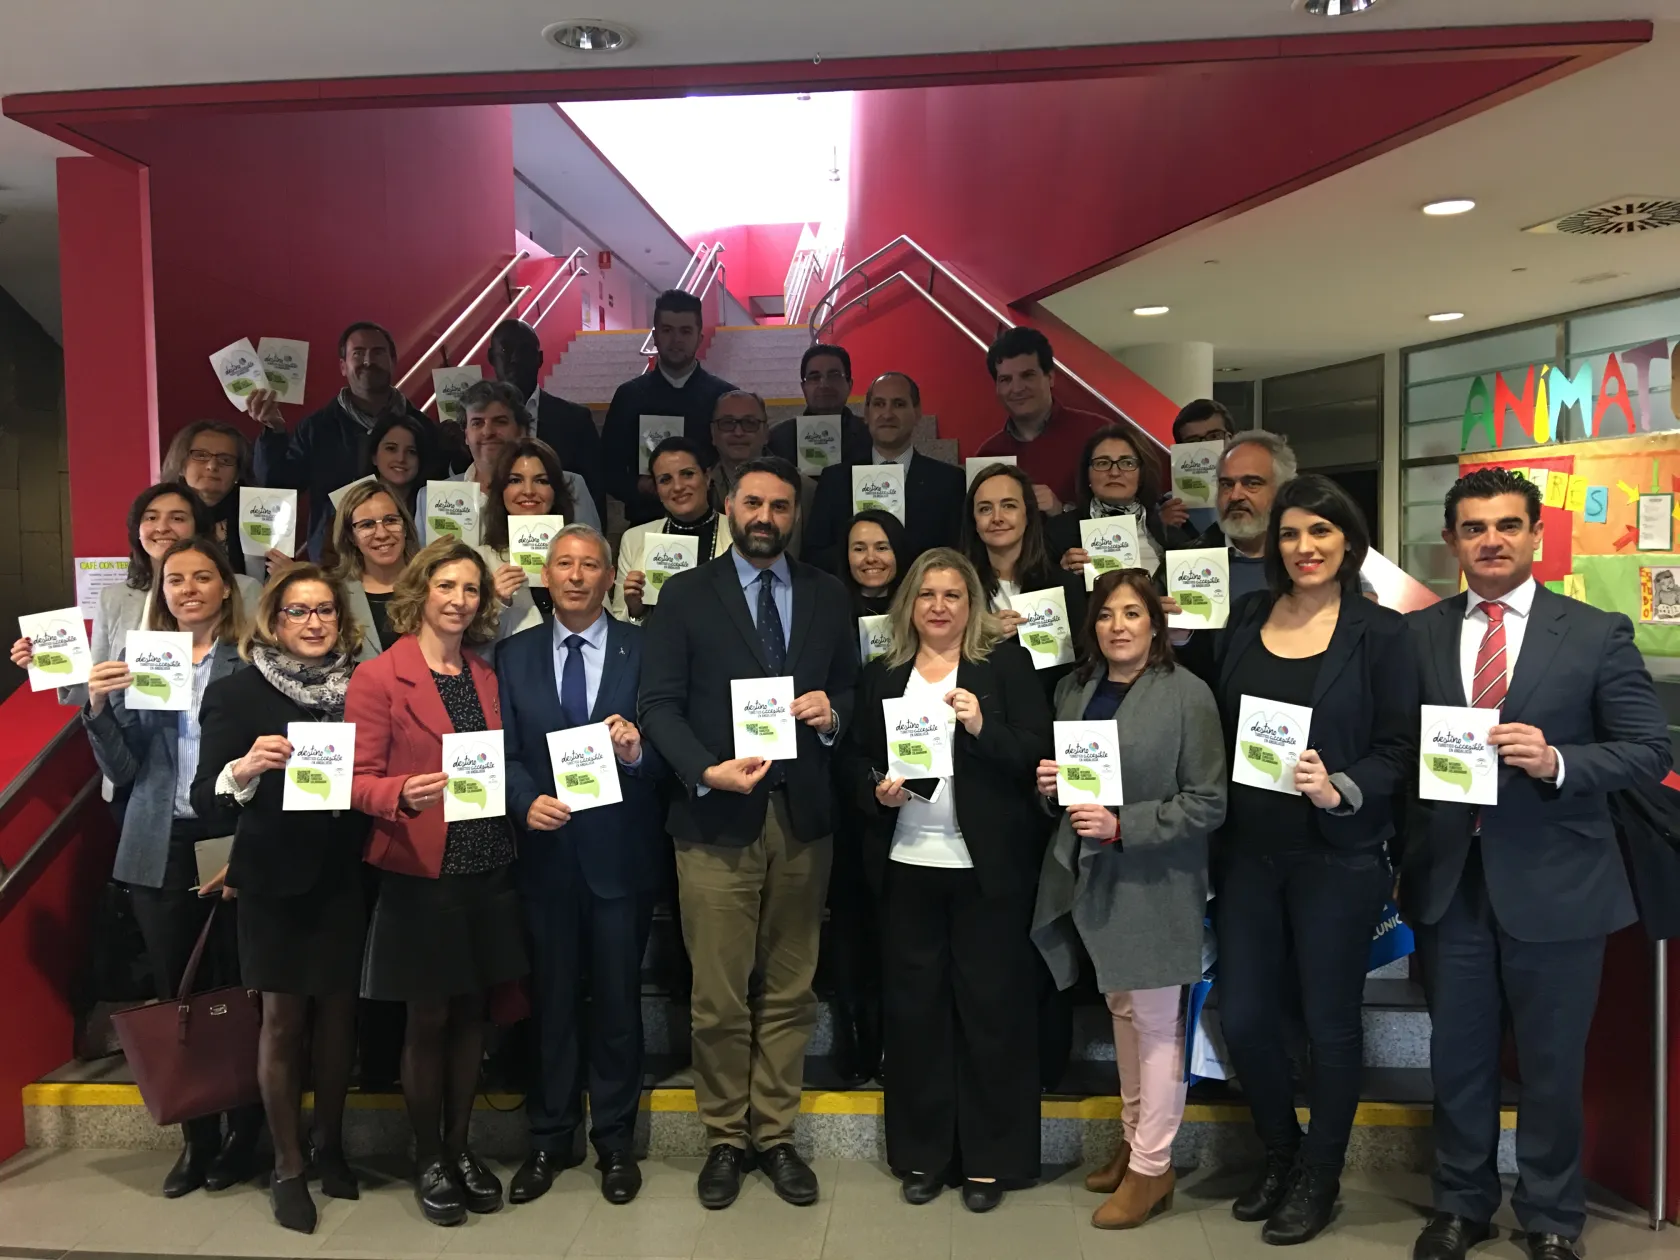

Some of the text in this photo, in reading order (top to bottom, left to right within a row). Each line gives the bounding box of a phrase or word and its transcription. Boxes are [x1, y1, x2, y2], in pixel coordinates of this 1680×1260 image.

[1461, 337, 1680, 452] ANÍMAT
[1178, 570, 1201, 581] destino
[136, 652, 161, 662] destino
[896, 719, 919, 731] destino
[1251, 721, 1276, 735] destino
[1270, 736, 1296, 745] accesible
[1433, 731, 1461, 743] destino
[297, 745, 323, 756] destino
[1065, 743, 1089, 754] destino
[453, 755, 476, 767] destino
